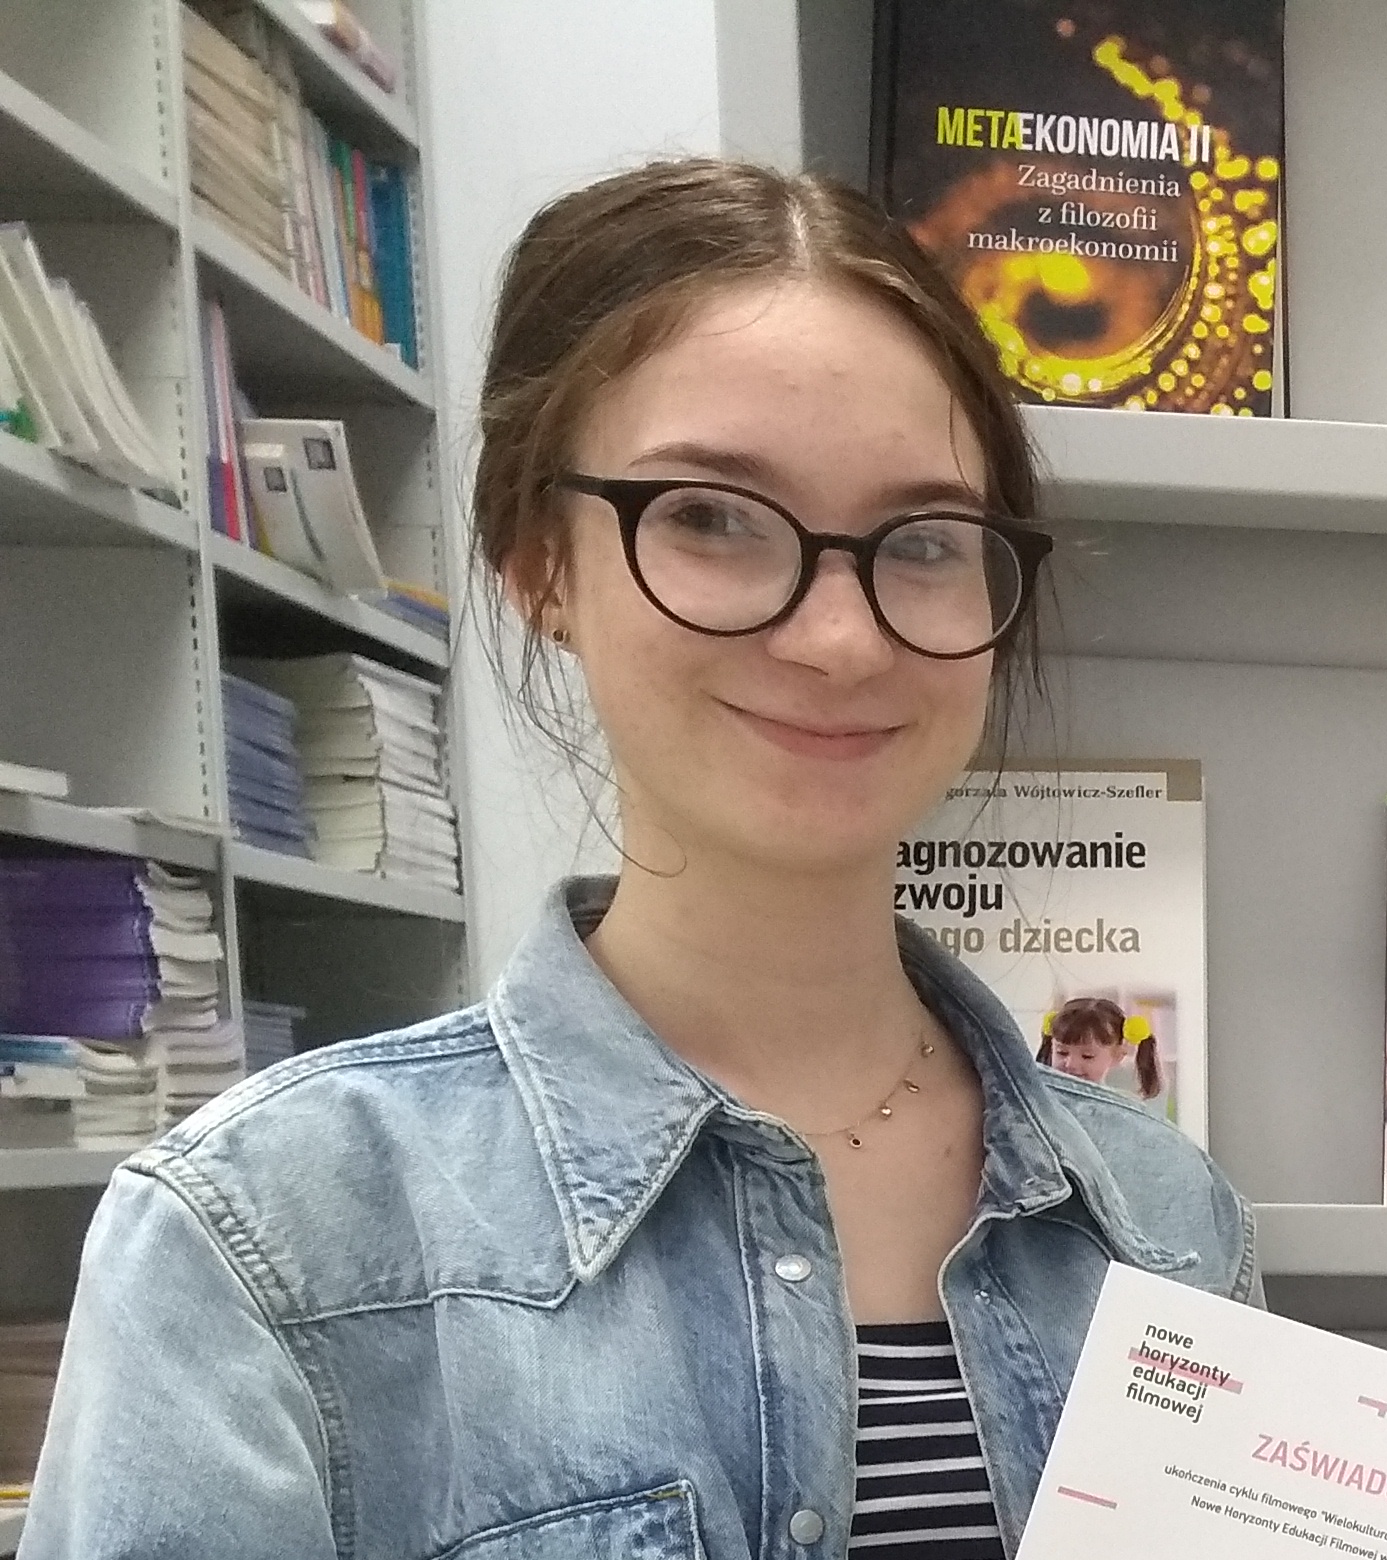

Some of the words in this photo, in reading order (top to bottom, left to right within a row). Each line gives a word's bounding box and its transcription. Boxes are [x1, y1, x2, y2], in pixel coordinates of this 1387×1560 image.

[1189, 123, 1211, 163] II
[1017, 164, 1181, 197] Zagadnienia
[1038, 206, 1052, 224] z
[1060, 202, 1157, 231] filozofii
[968, 228, 1178, 263] makroekonomii
[945, 785, 1008, 800] gorzata
[1015, 784, 1163, 800] Wójtowicz-Szefler
[896, 831, 1146, 876] agnozowanie
[893, 873, 1003, 918] zwoju
[1000, 918, 1141, 954] dziecka
[1144, 1323, 1194, 1349] nowe
[1131, 1363, 1208, 1400] edukacji
[1138, 1341, 1230, 1386] horyzonty
[1126, 1382, 1204, 1423] filmowej
[1163, 1464, 1228, 1493] ukończenia
[1228, 1485, 1260, 1502] cyklu
[1260, 1491, 1318, 1521] filmowego
[1190, 1494, 1223, 1515] Nowe
[1223, 1504, 1282, 1534] Horyzonty
[1281, 1521, 1330, 1548] Edukacji
